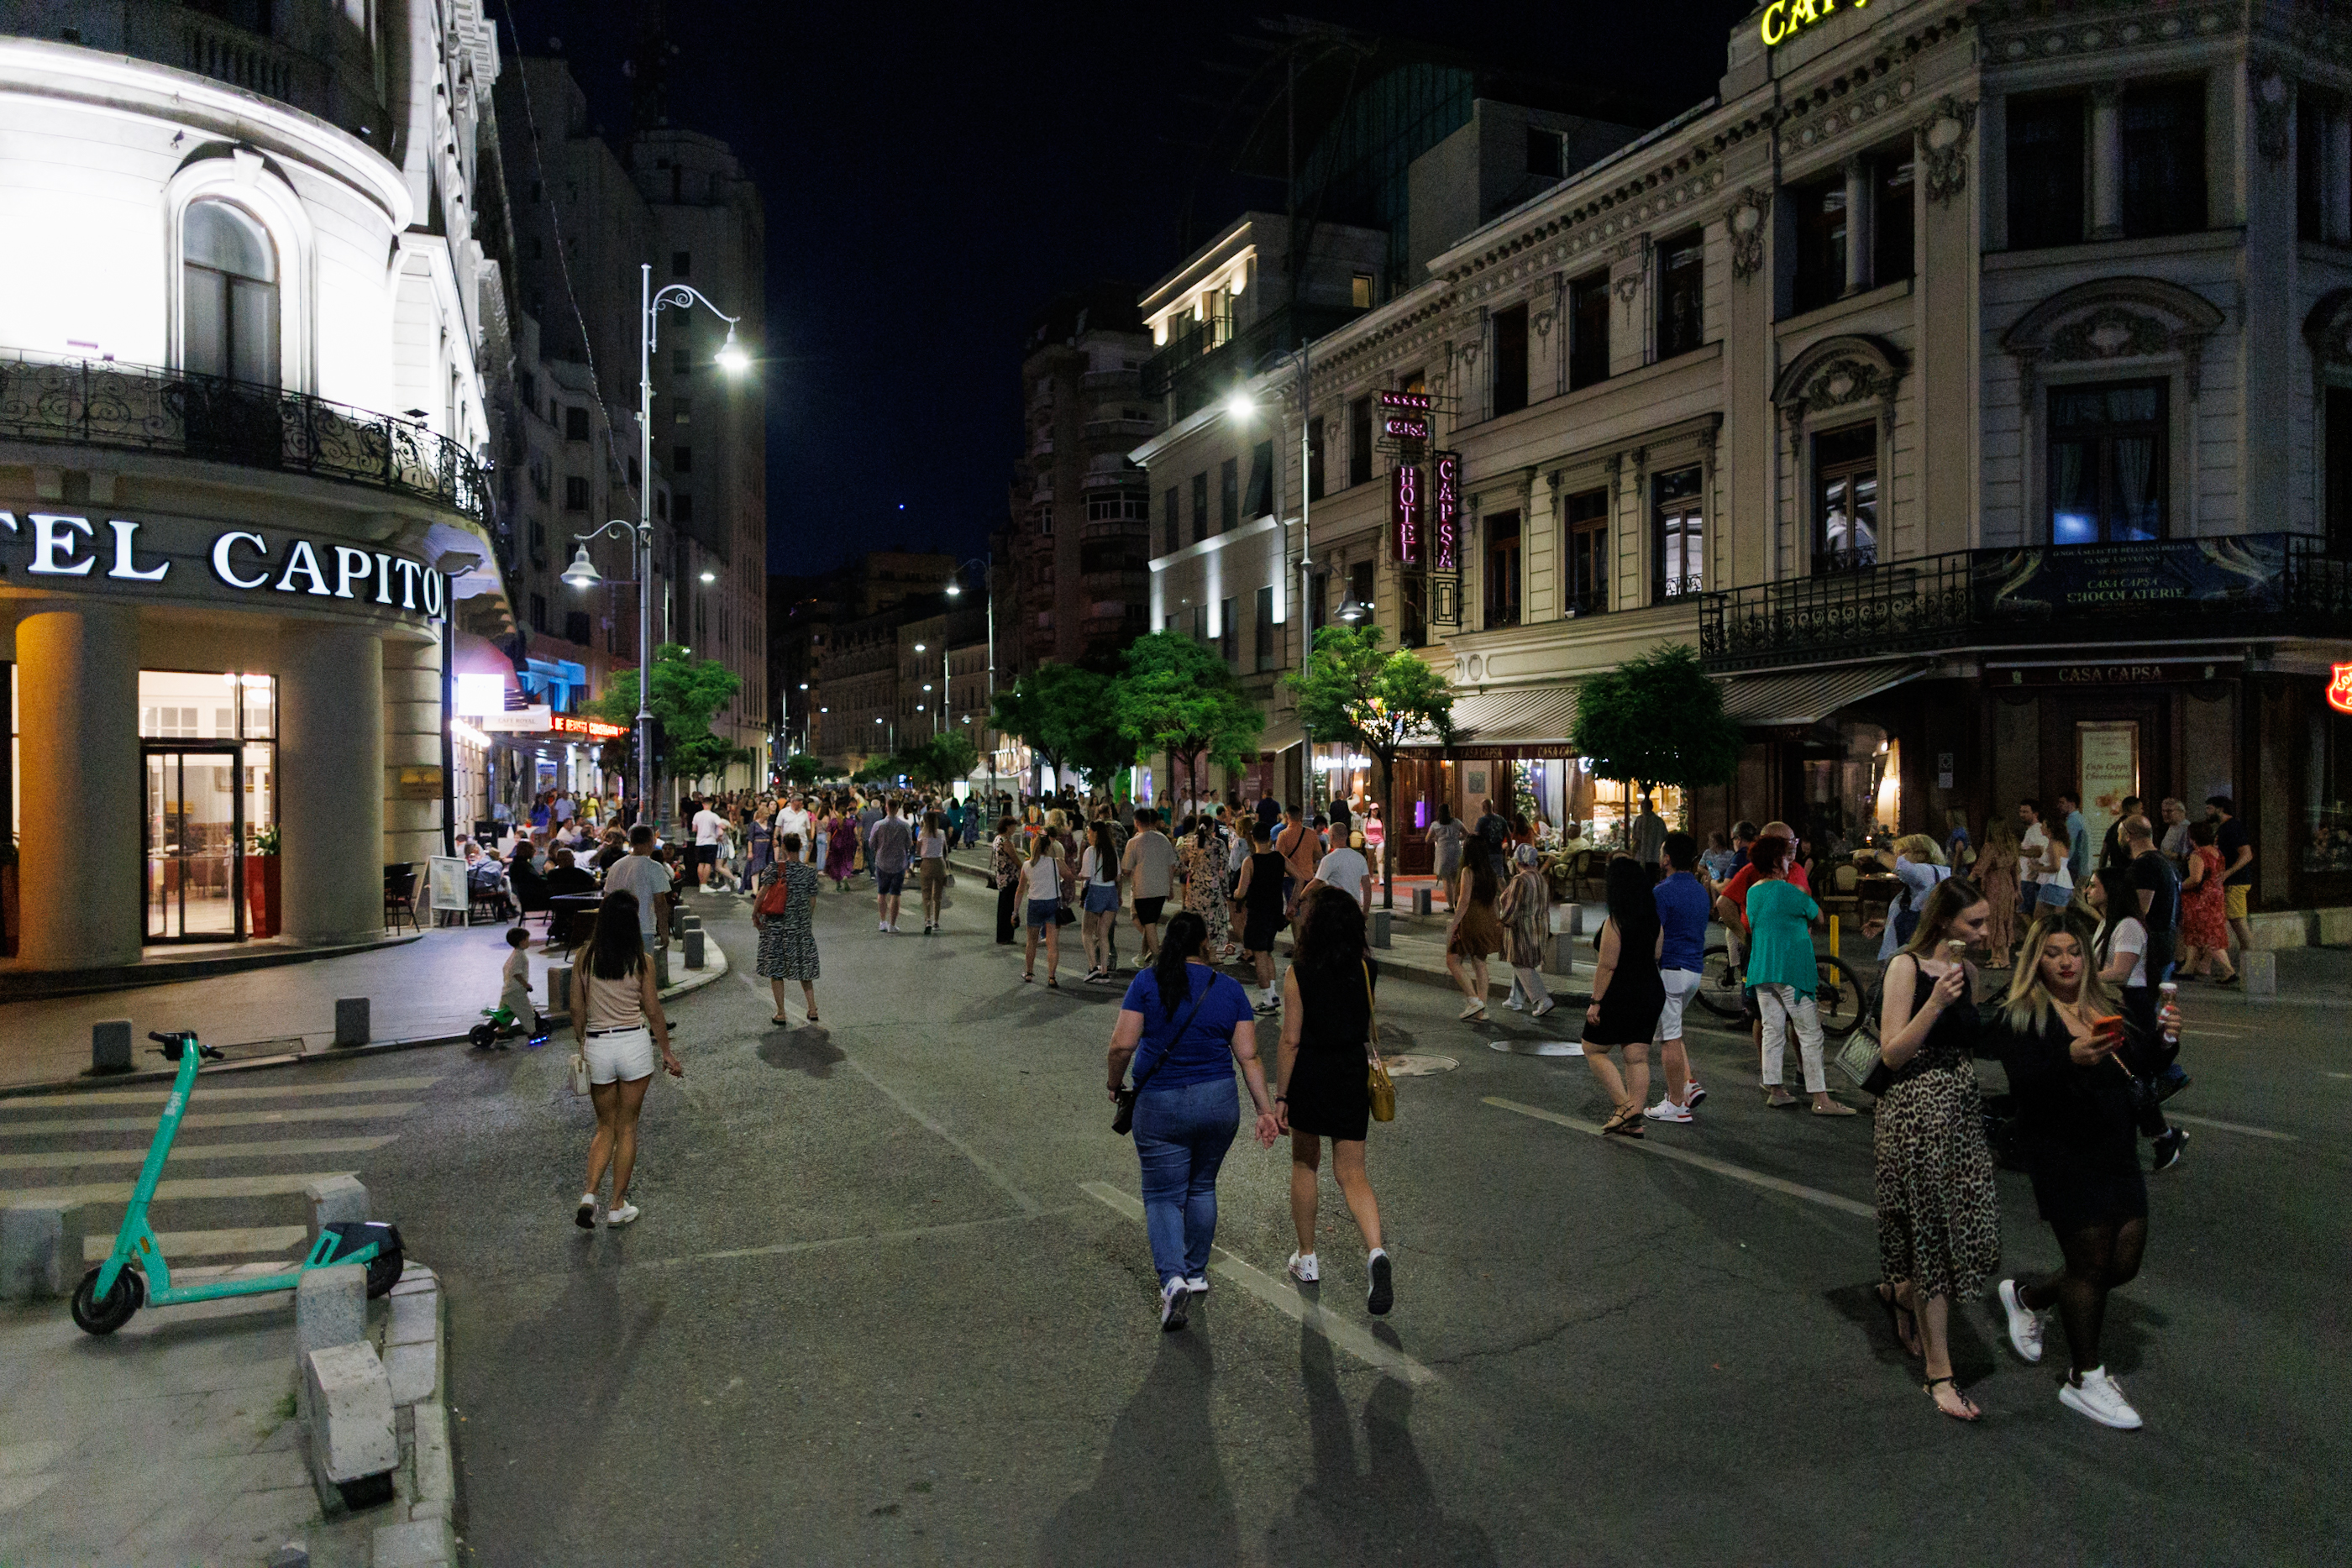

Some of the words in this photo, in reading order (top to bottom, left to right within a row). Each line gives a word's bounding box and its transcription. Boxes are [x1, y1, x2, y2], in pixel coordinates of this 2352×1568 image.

[1761, 0, 1866, 45] CA
[1400, 466, 1416, 564] HOTEL
[1438, 459, 1455, 568] CAPSA
[2087, 579, 2118, 589] CASA
[2058, 667, 2103, 682] CASA
[1461, 747, 1478, 758] CASA
[1538, 747, 1558, 758] CASA
